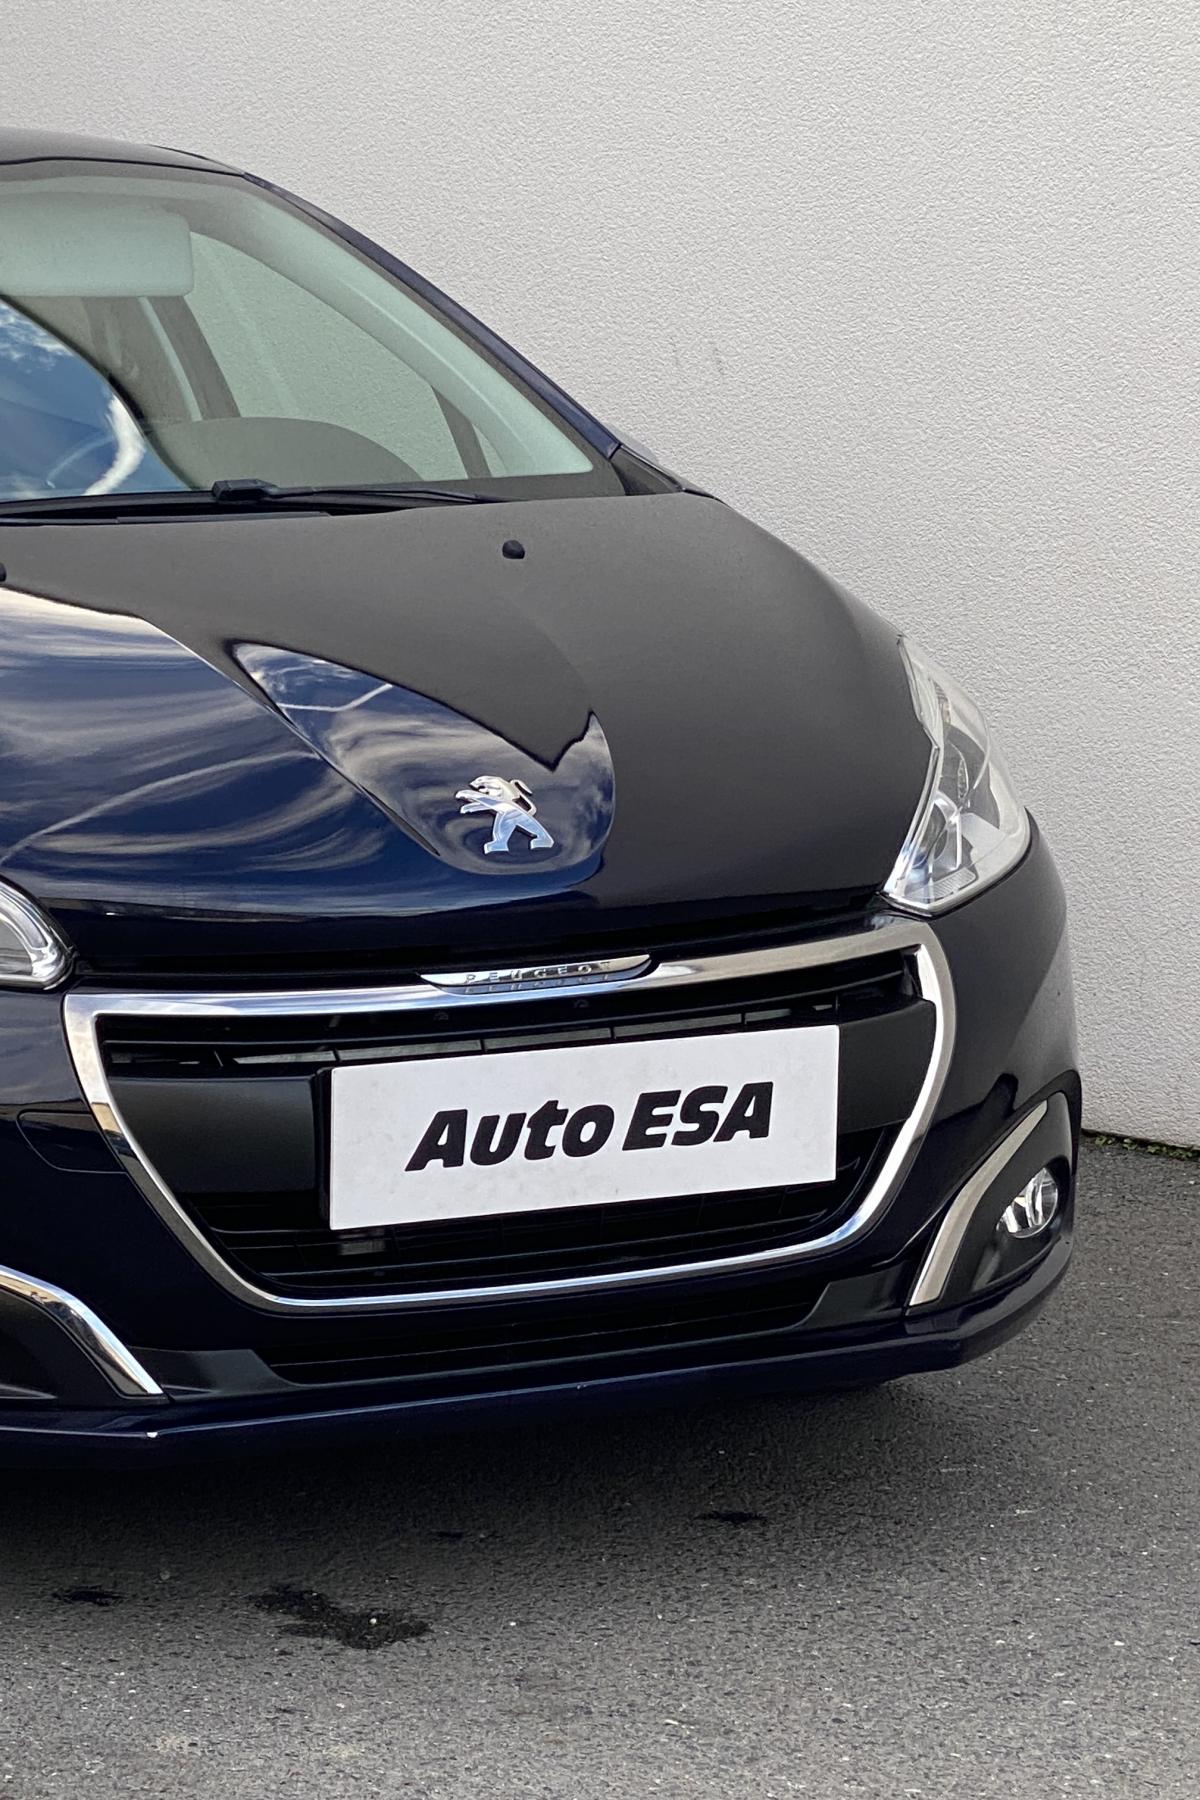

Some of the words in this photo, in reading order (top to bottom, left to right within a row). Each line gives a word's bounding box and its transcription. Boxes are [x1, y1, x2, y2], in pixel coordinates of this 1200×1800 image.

[465, 961, 611, 983] PEUGEOT
[405, 1100, 614, 1171] Auto
[622, 1082, 774, 1151] ESA
